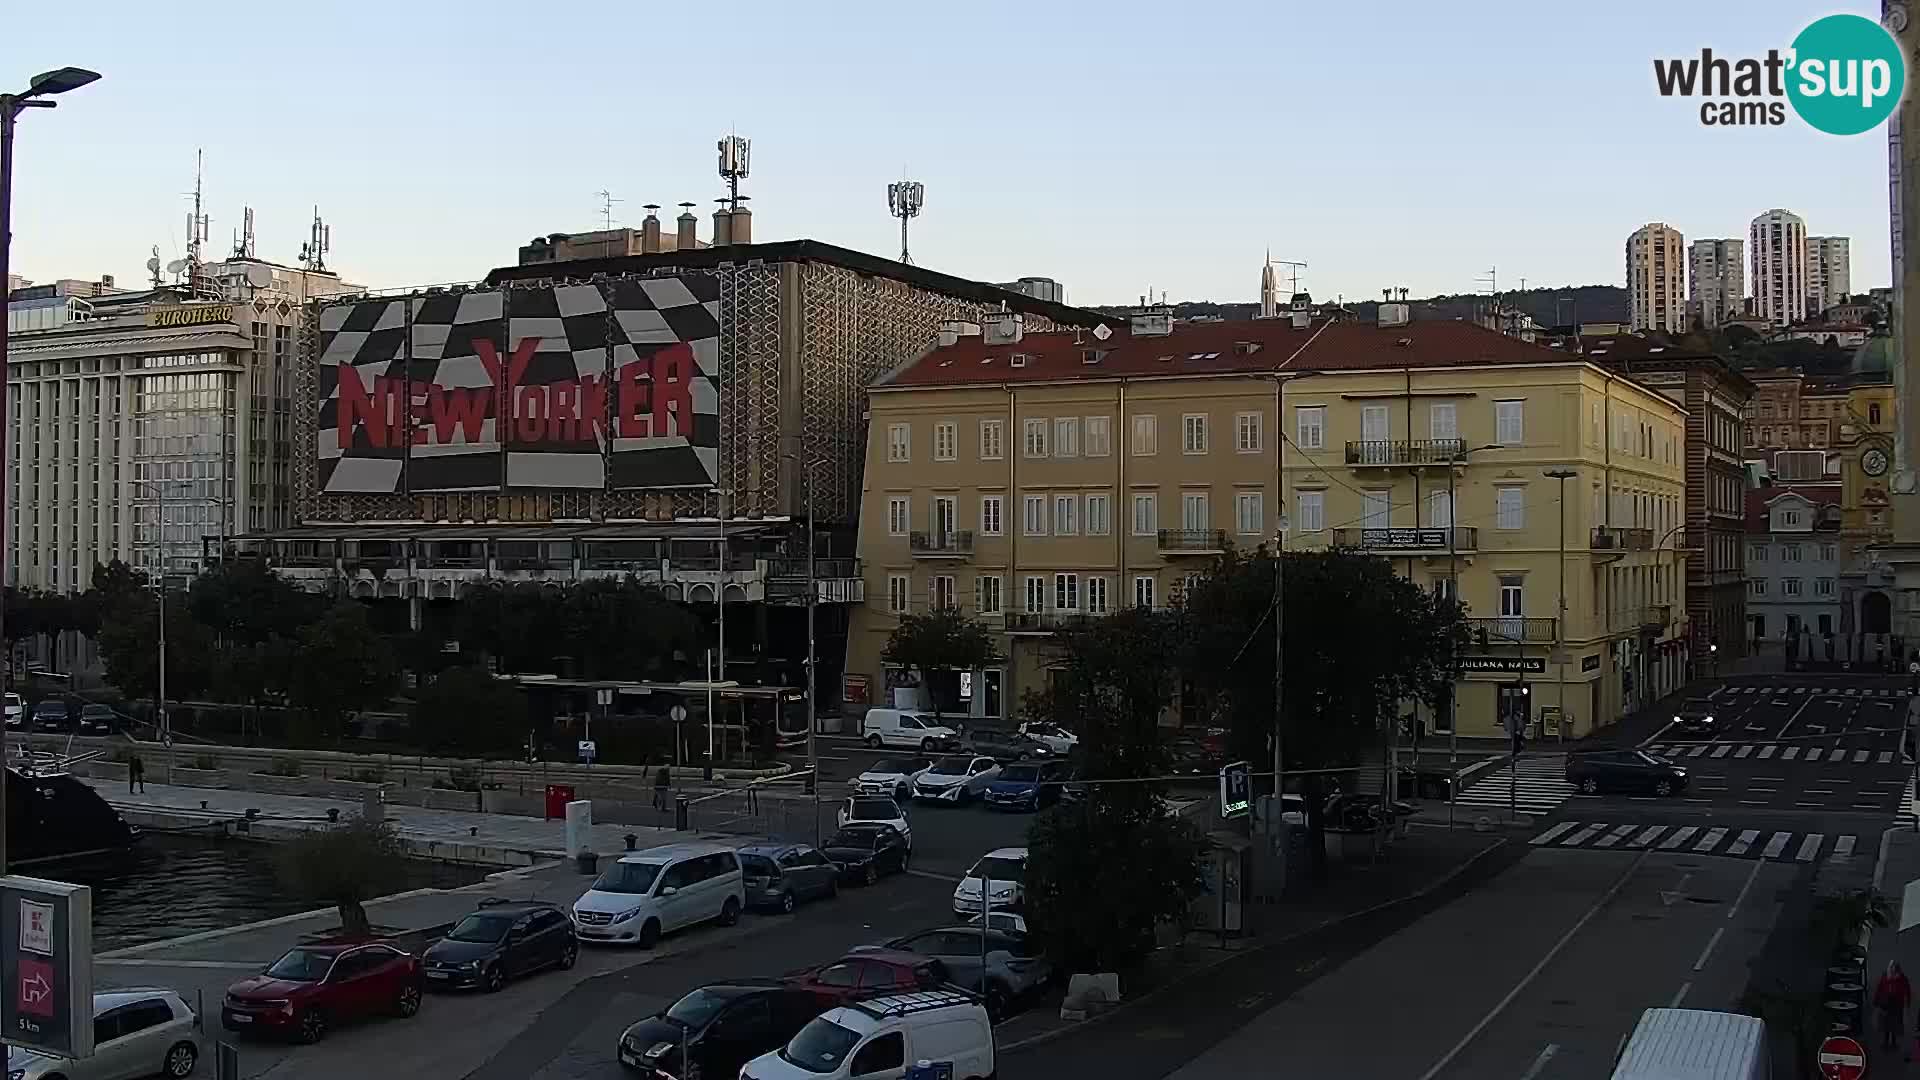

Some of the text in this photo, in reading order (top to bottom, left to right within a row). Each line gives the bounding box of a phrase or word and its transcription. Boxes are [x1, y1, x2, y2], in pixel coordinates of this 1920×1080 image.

[1459, 660, 1540, 670] JULIANA NAILS
[19, 1018, 40, 1033] 5 km
